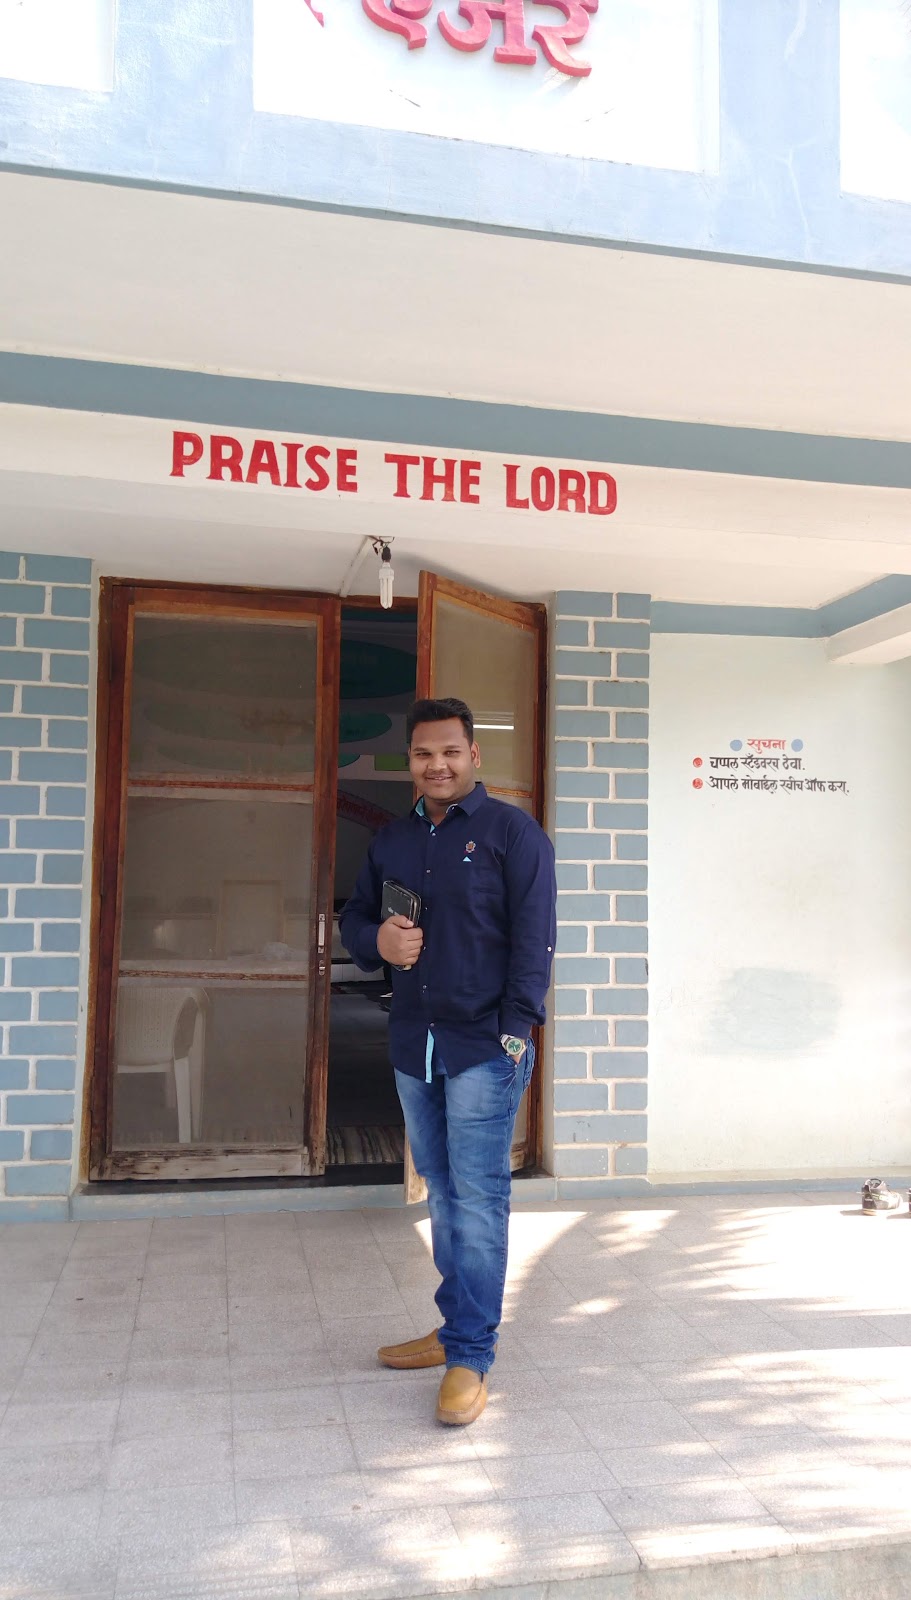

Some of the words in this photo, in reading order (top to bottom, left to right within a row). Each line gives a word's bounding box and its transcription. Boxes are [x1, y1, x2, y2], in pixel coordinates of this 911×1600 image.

[169, 431, 358, 493] PRAISE
[384, 453, 481, 504] THE
[502, 463, 618, 515] LORD
[709, 756, 738, 771] चप्पल
[705, 774, 738, 793] आपले
[827, 780, 849, 796] करा.
